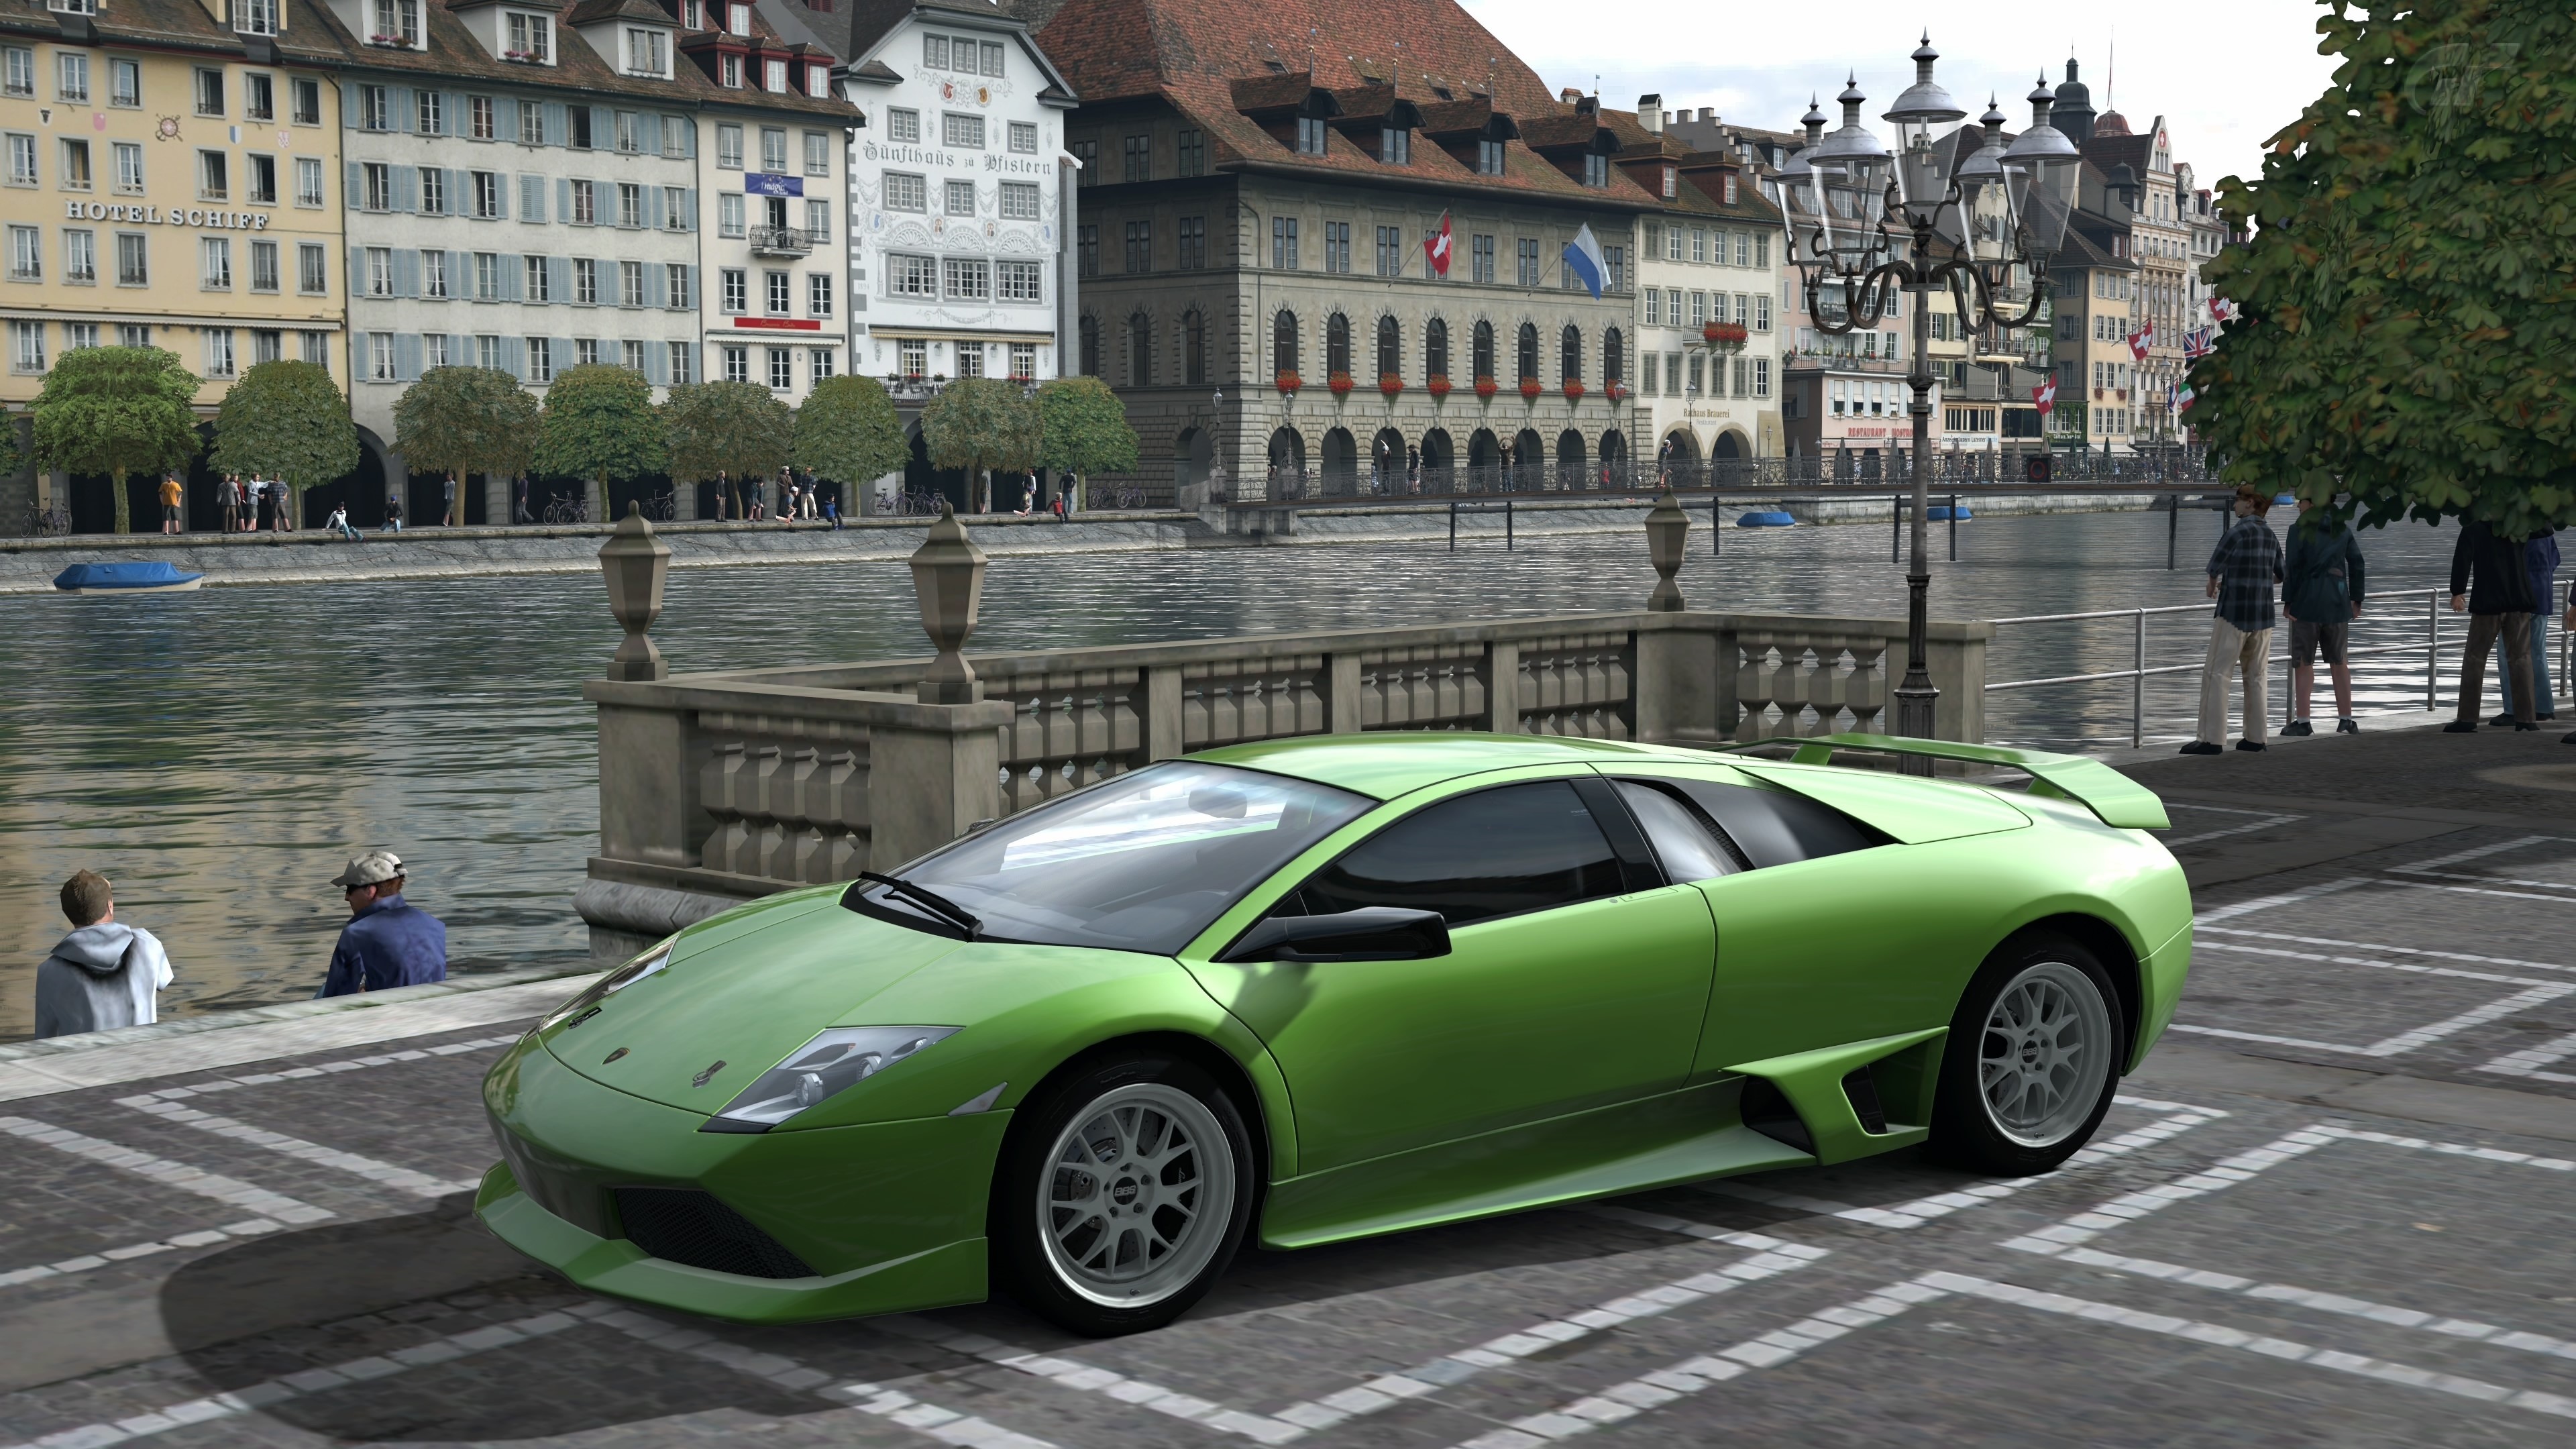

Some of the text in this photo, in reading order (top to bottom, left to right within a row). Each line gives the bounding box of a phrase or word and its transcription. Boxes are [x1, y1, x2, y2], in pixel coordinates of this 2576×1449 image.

[65, 201, 268, 229] HOTEL SCHIFF
[1707, 409, 1729, 418] Brauerei
[1848, 427, 1886, 437] RESTAURANT
[2023, 1047, 2037, 1056] BBS
[1114, 1185, 1136, 1197] BBS
